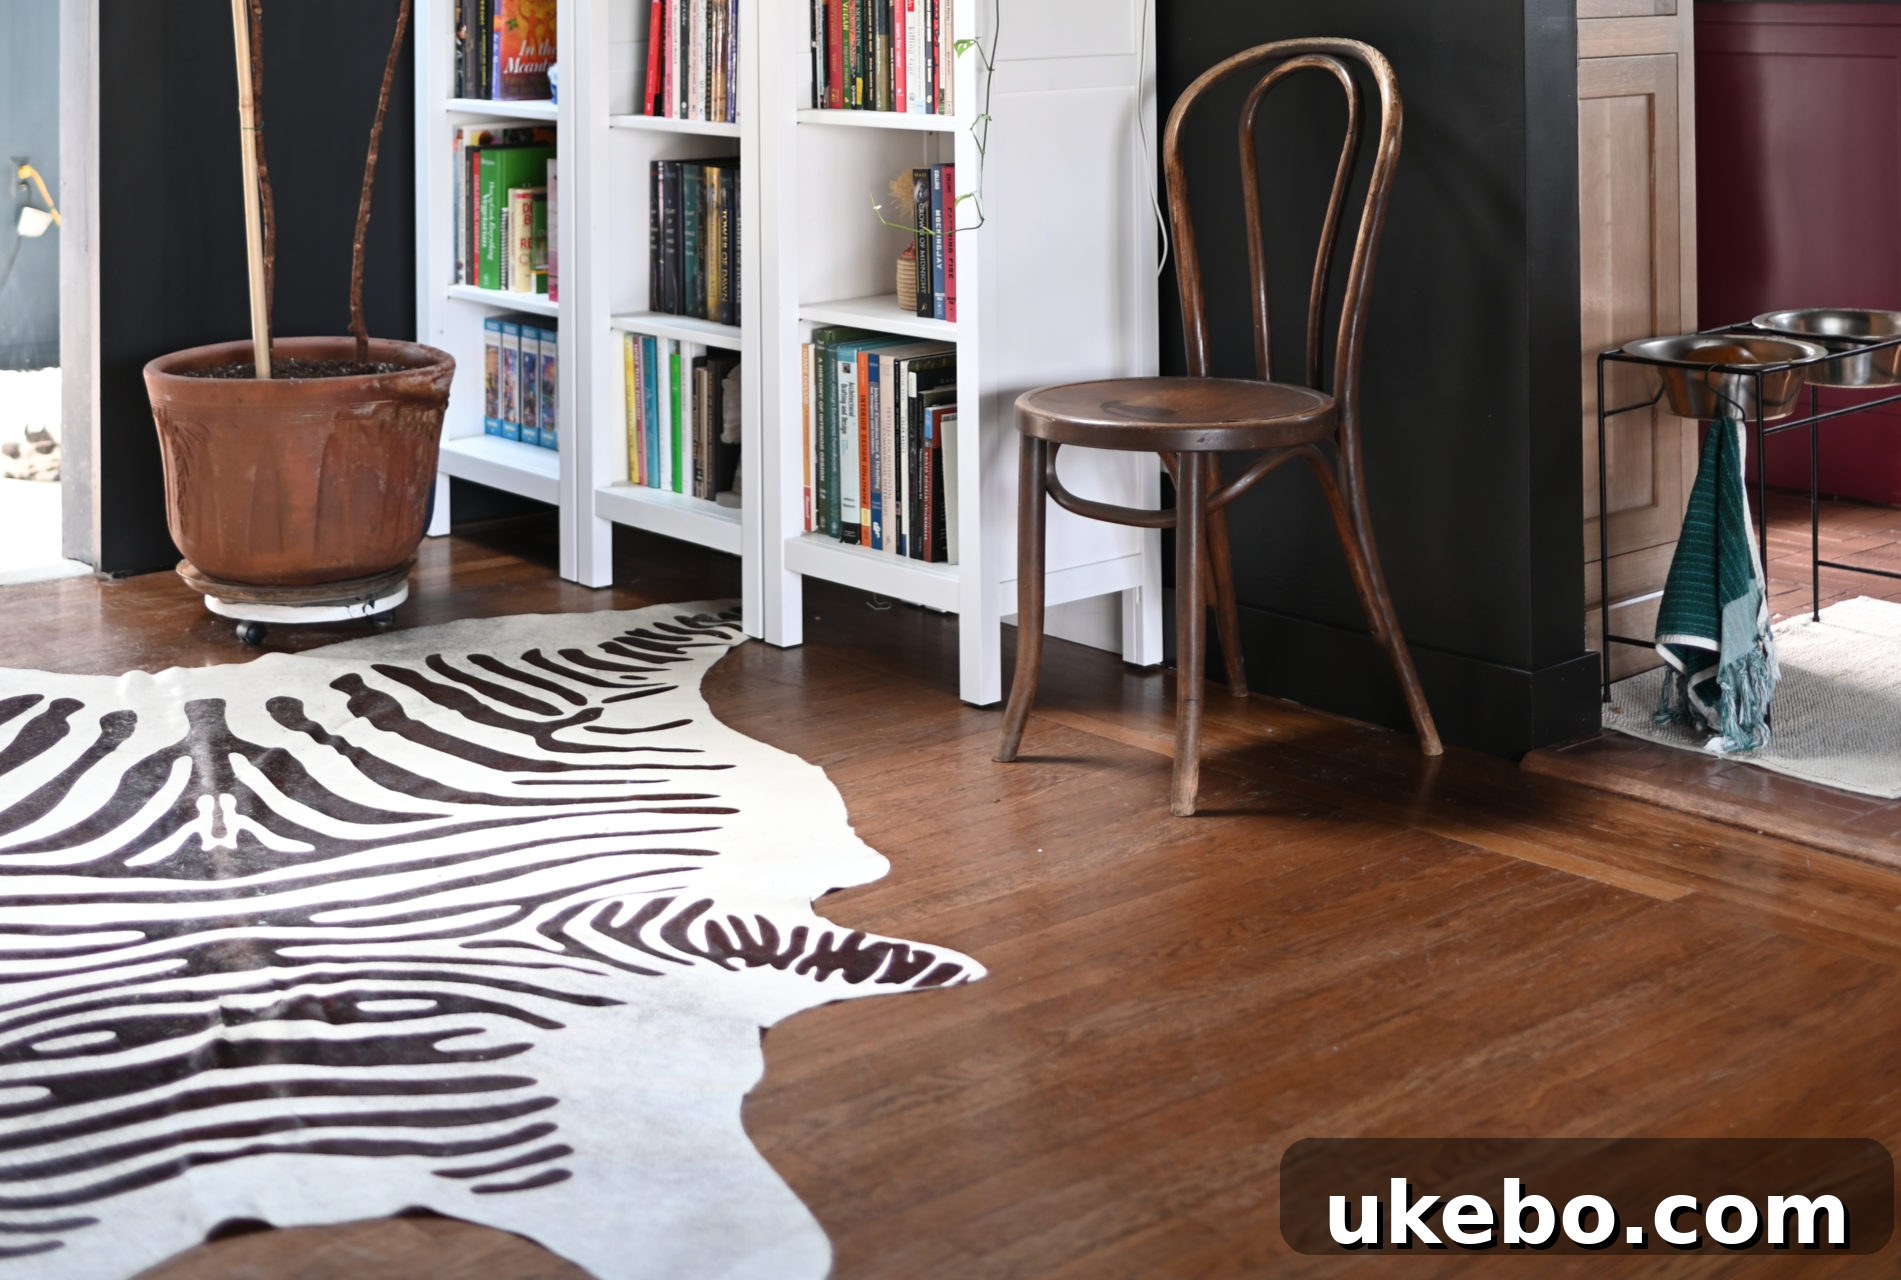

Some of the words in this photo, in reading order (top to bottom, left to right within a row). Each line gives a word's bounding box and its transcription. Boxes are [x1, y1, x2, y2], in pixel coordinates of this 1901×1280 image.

[520, 40, 534, 57] In
[906, 26, 915, 55] killing
[480, 193, 490, 248] Vegetarian
[487, 220, 496, 261] Everything
[920, 237, 926, 248] OF
[721, 251, 728, 267] OF
[840, 383, 848, 404] Drafting
[848, 382, 856, 417] Architectural
[818, 400, 824, 411] OF
[841, 405, 849, 416] and
[860, 394, 868, 431] INTERIOR
[840, 416, 850, 434] Design
